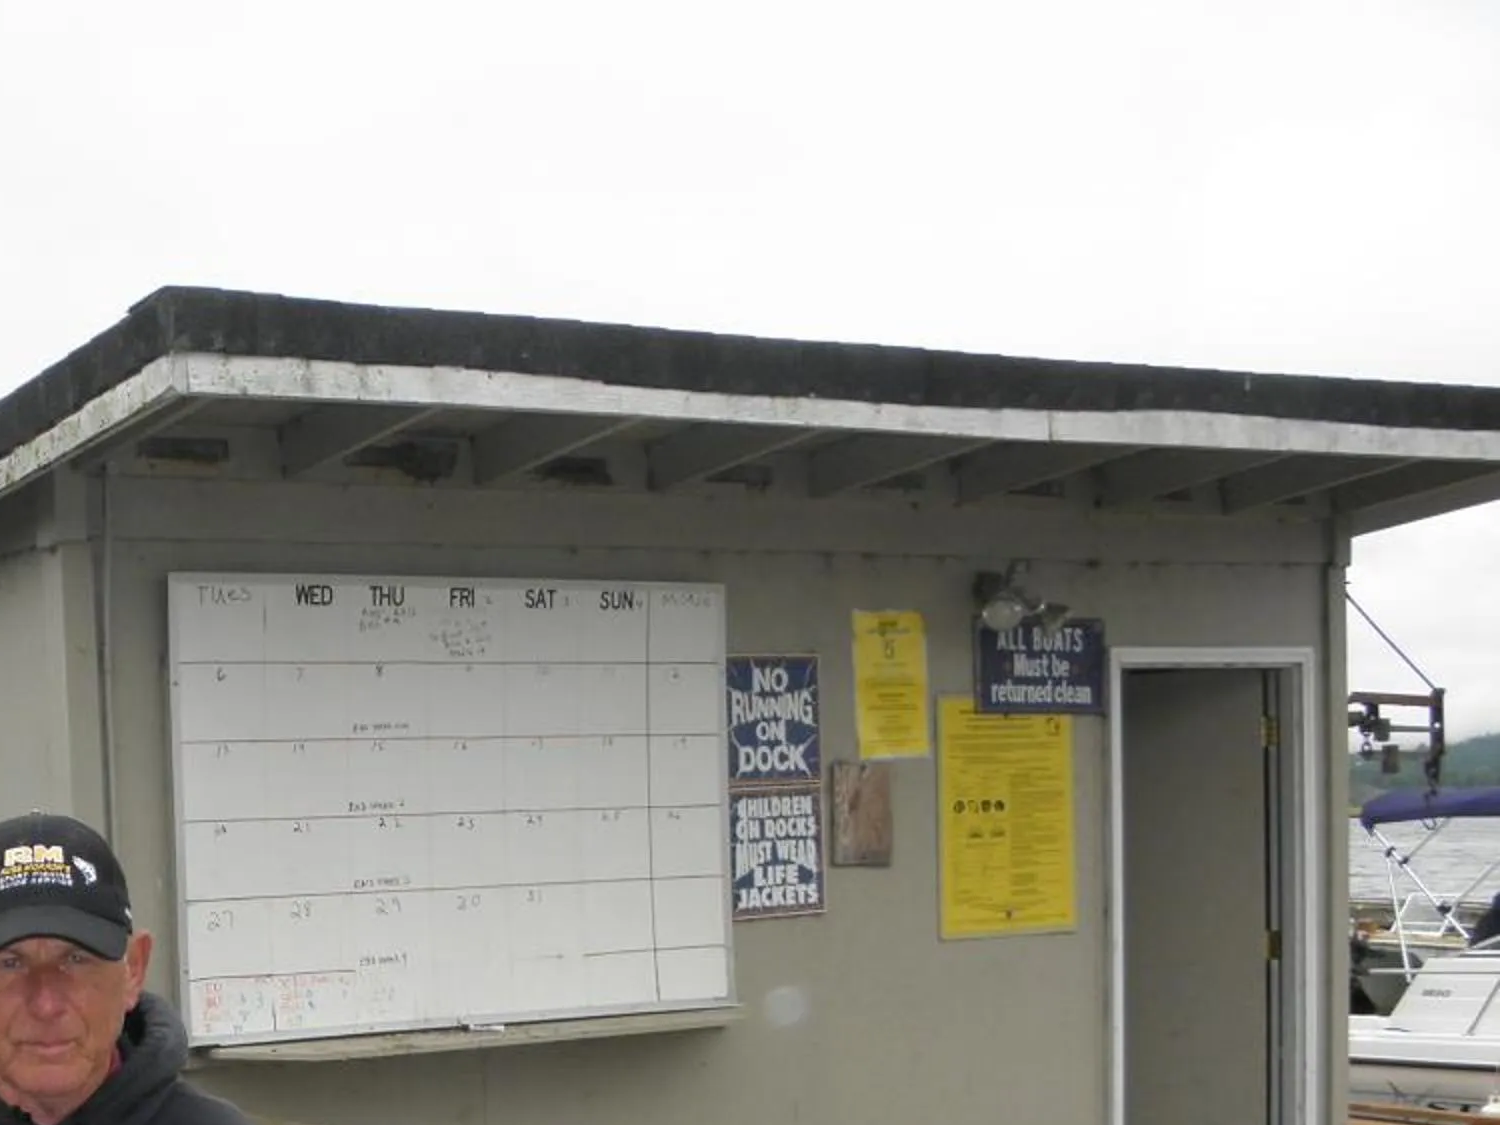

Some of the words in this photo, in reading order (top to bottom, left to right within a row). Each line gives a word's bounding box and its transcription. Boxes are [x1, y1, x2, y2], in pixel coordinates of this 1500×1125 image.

[296, 585, 333, 606] WED
[369, 586, 405, 606] THU
[449, 587, 475, 608] FRI
[524, 589, 557, 609] SAT
[600, 591, 634, 610] SUN
[997, 627, 1027, 651] ALL
[1032, 627, 1084, 653] BOATS
[1013, 653, 1049, 678] Must
[1051, 653, 1071, 678] be
[752, 667, 789, 693] NO
[991, 679, 1052, 704] returned
[1054, 679, 1092, 704] clean
[731, 688, 815, 726] RUNNING
[756, 718, 786, 743] ON
[738, 744, 811, 775] DOCK
[737, 796, 812, 818] CHILDREN
[736, 818, 760, 840] ON
[764, 816, 816, 838] DOCKS
[4, 845, 65, 867] RM
[735, 841, 773, 880] MUST
[775, 838, 817, 872] WEAR
[753, 863, 799, 887] LIFE
[737, 884, 818, 911] JACKETS
